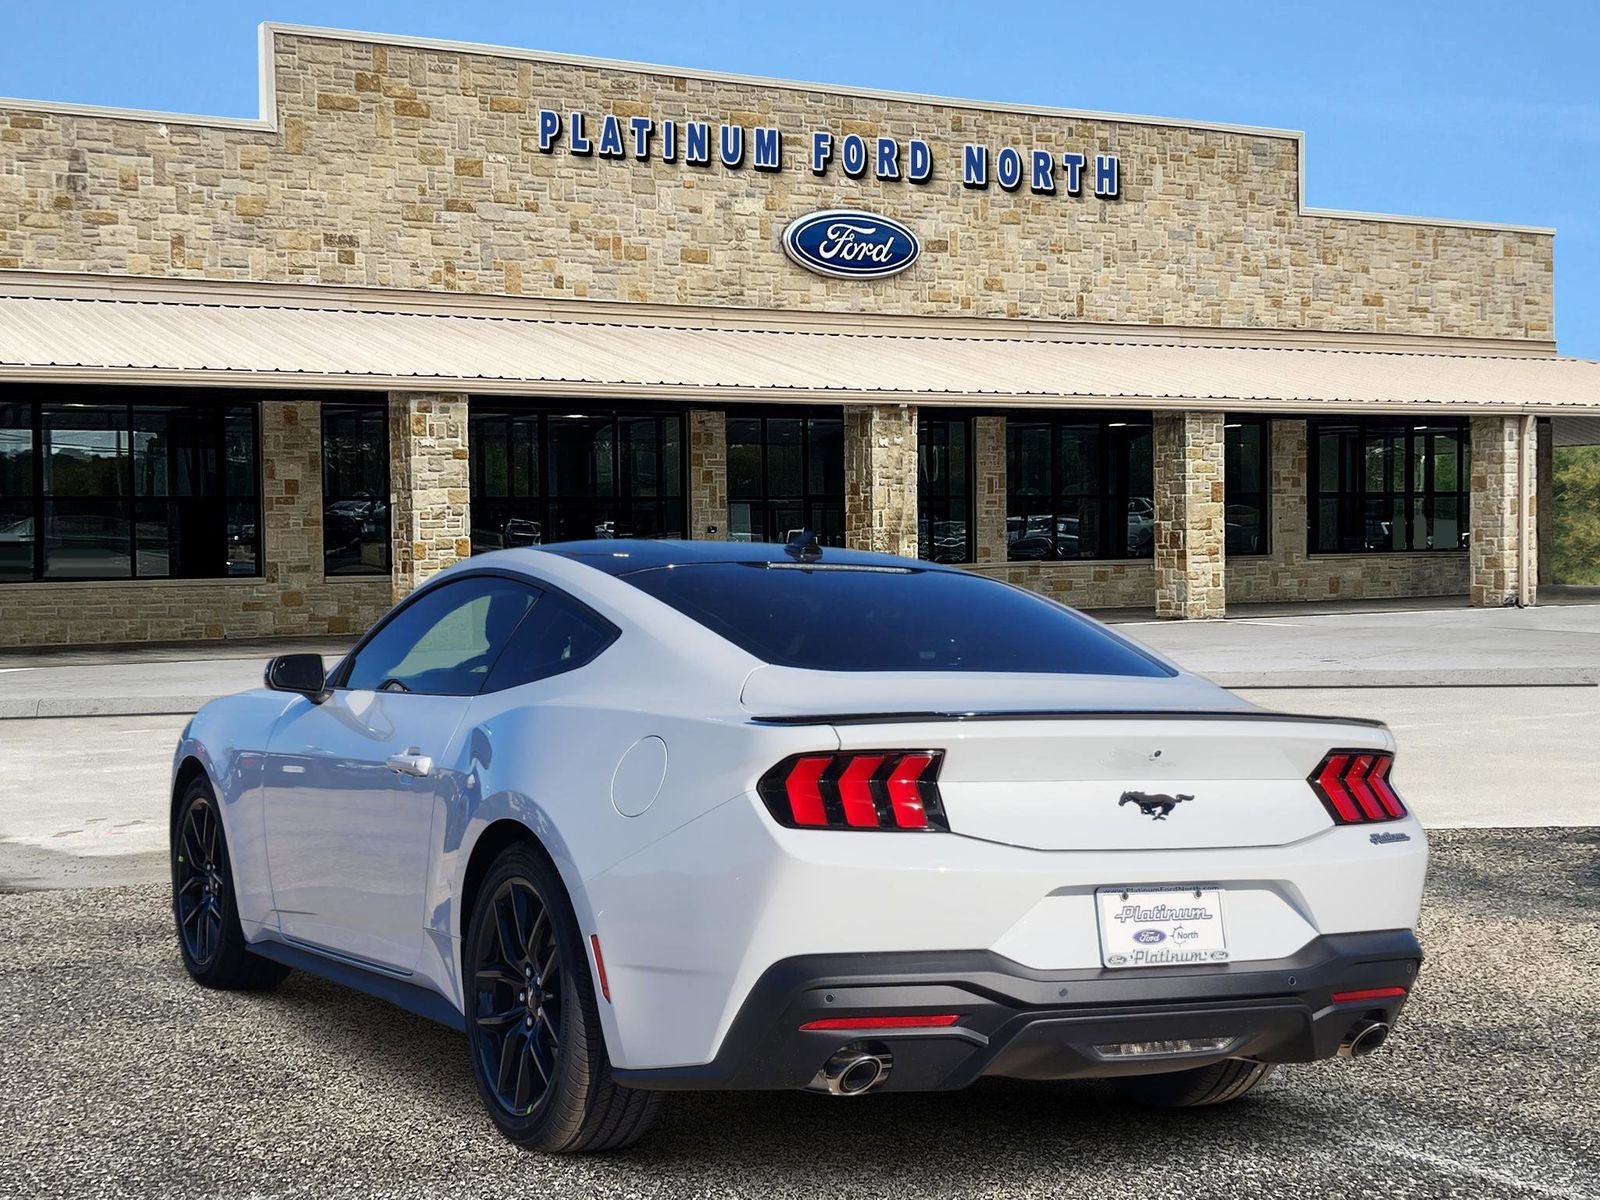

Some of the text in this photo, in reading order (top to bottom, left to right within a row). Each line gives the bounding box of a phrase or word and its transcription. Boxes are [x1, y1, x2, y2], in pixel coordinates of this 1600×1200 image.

[538, 109, 1121, 199] PLATINUM FORD NORTH
[818, 223, 894, 264] Ford
[1114, 904, 1213, 923] Platinum
[1139, 931, 1161, 943] Ford
[1177, 930, 1199, 940] North
